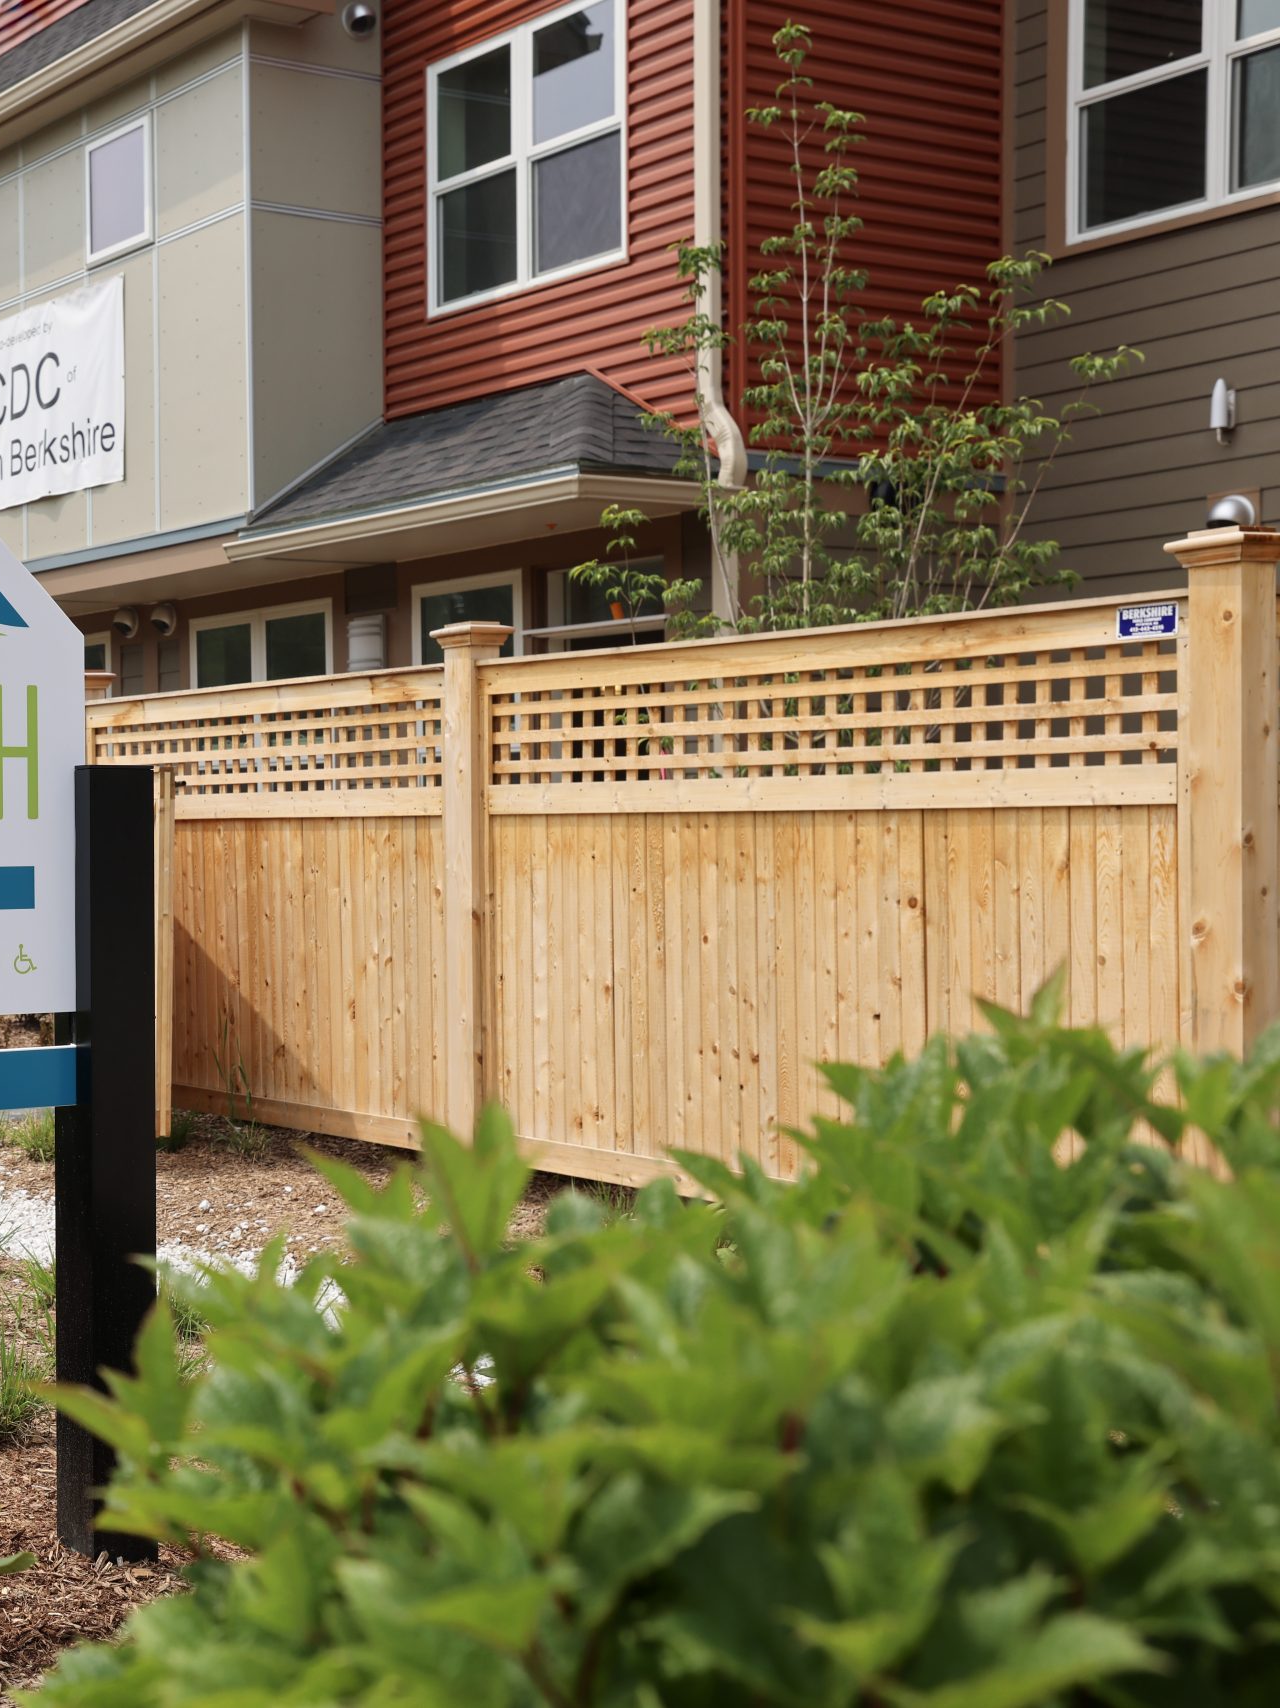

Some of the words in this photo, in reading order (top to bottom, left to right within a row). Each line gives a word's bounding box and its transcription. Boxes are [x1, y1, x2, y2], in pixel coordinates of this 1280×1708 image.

[66, 365, 77, 383] of
[11, 418, 116, 477] Berkshire
[1122, 605, 1174, 620] BERKSHIRE
